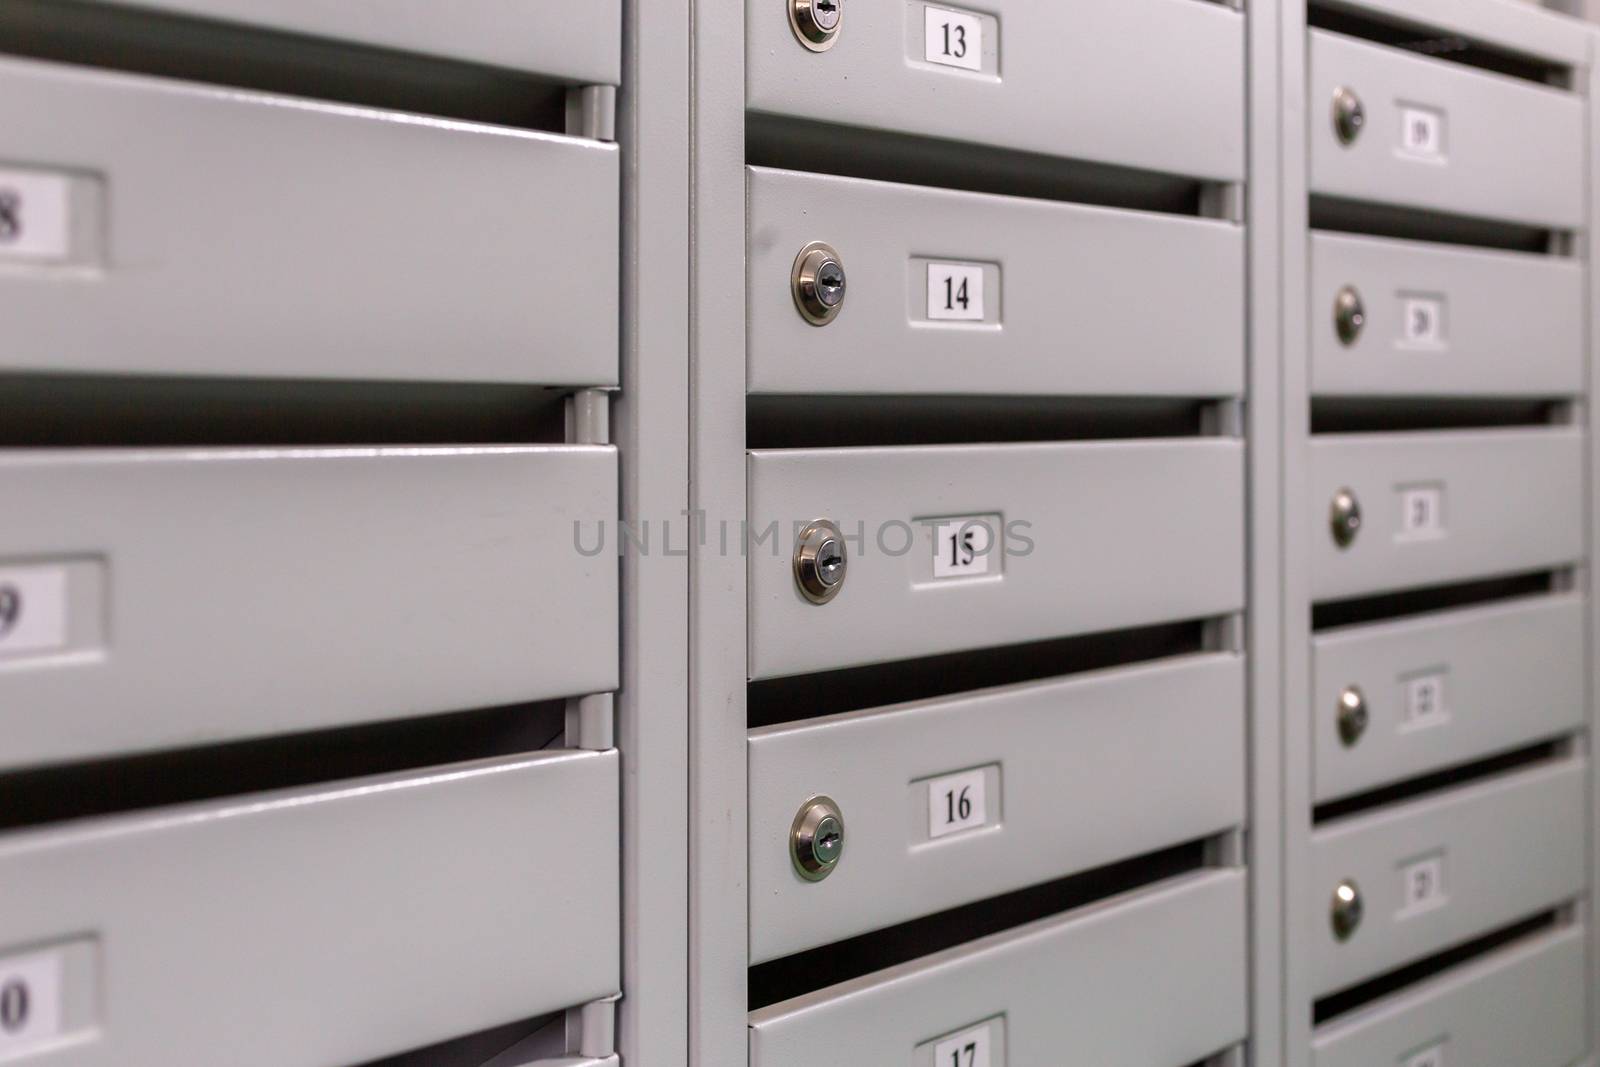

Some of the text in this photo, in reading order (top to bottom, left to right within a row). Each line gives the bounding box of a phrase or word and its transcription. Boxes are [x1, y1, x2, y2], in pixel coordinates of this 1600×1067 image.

[940, 22, 968, 58] 13
[943, 275, 970, 311] 14
[948, 531, 975, 567] 15
[945, 785, 972, 824] 16
